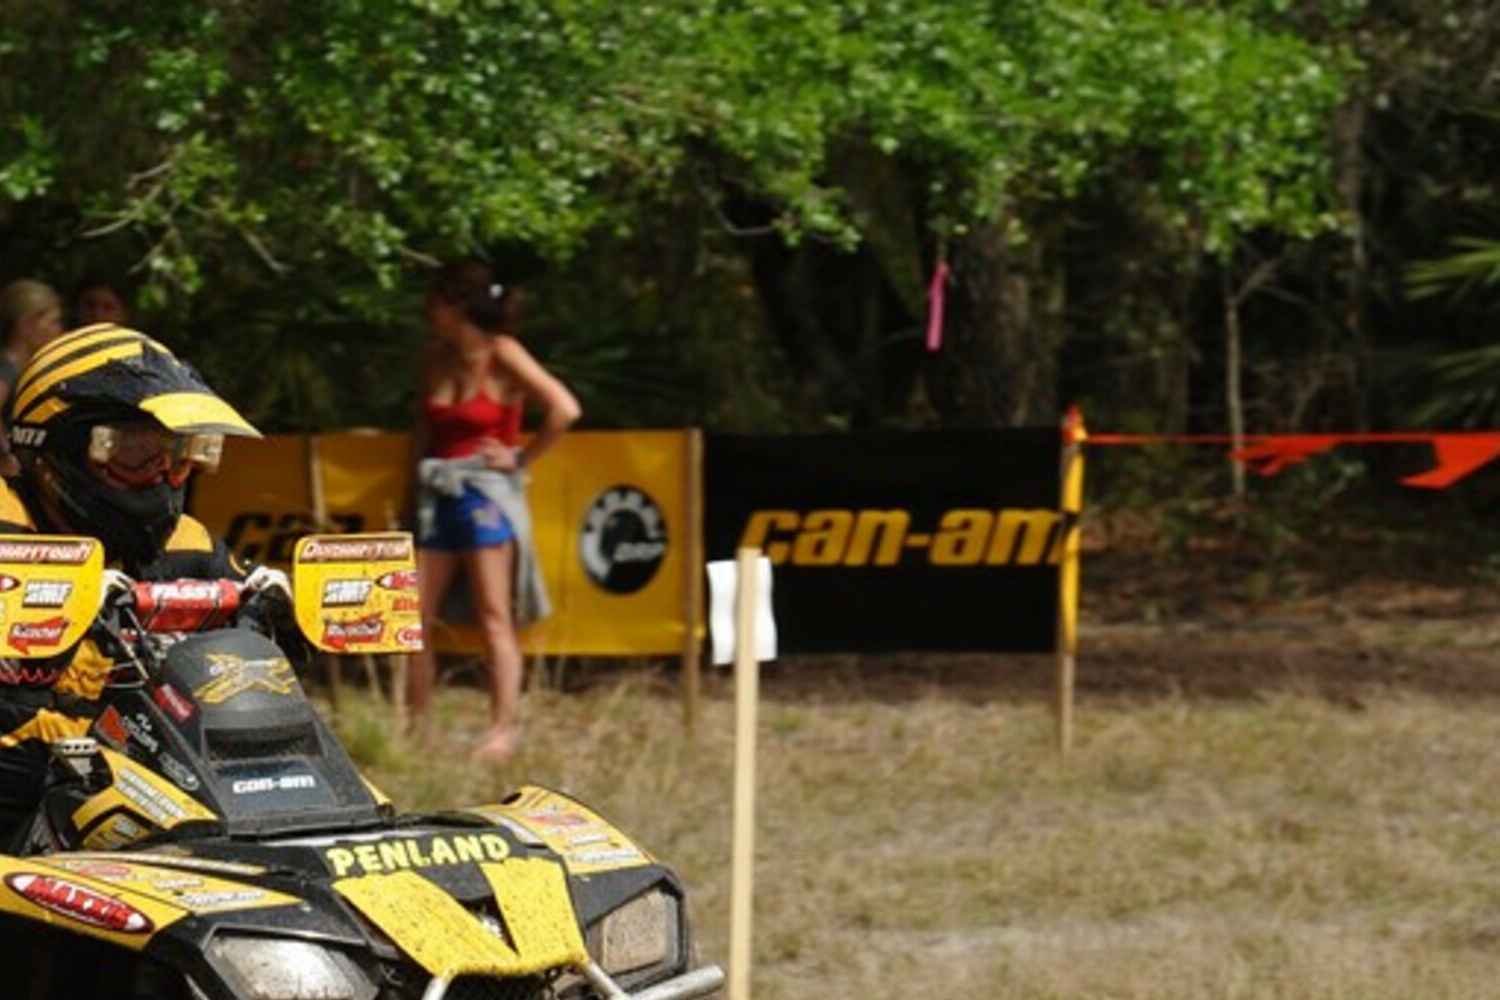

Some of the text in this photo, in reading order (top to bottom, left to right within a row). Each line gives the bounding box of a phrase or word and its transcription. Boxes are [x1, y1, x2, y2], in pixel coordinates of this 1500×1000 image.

[741, 509, 1063, 565] can-am
[150, 583, 221, 600] FASST
[327, 833, 510, 876] PENLAND
